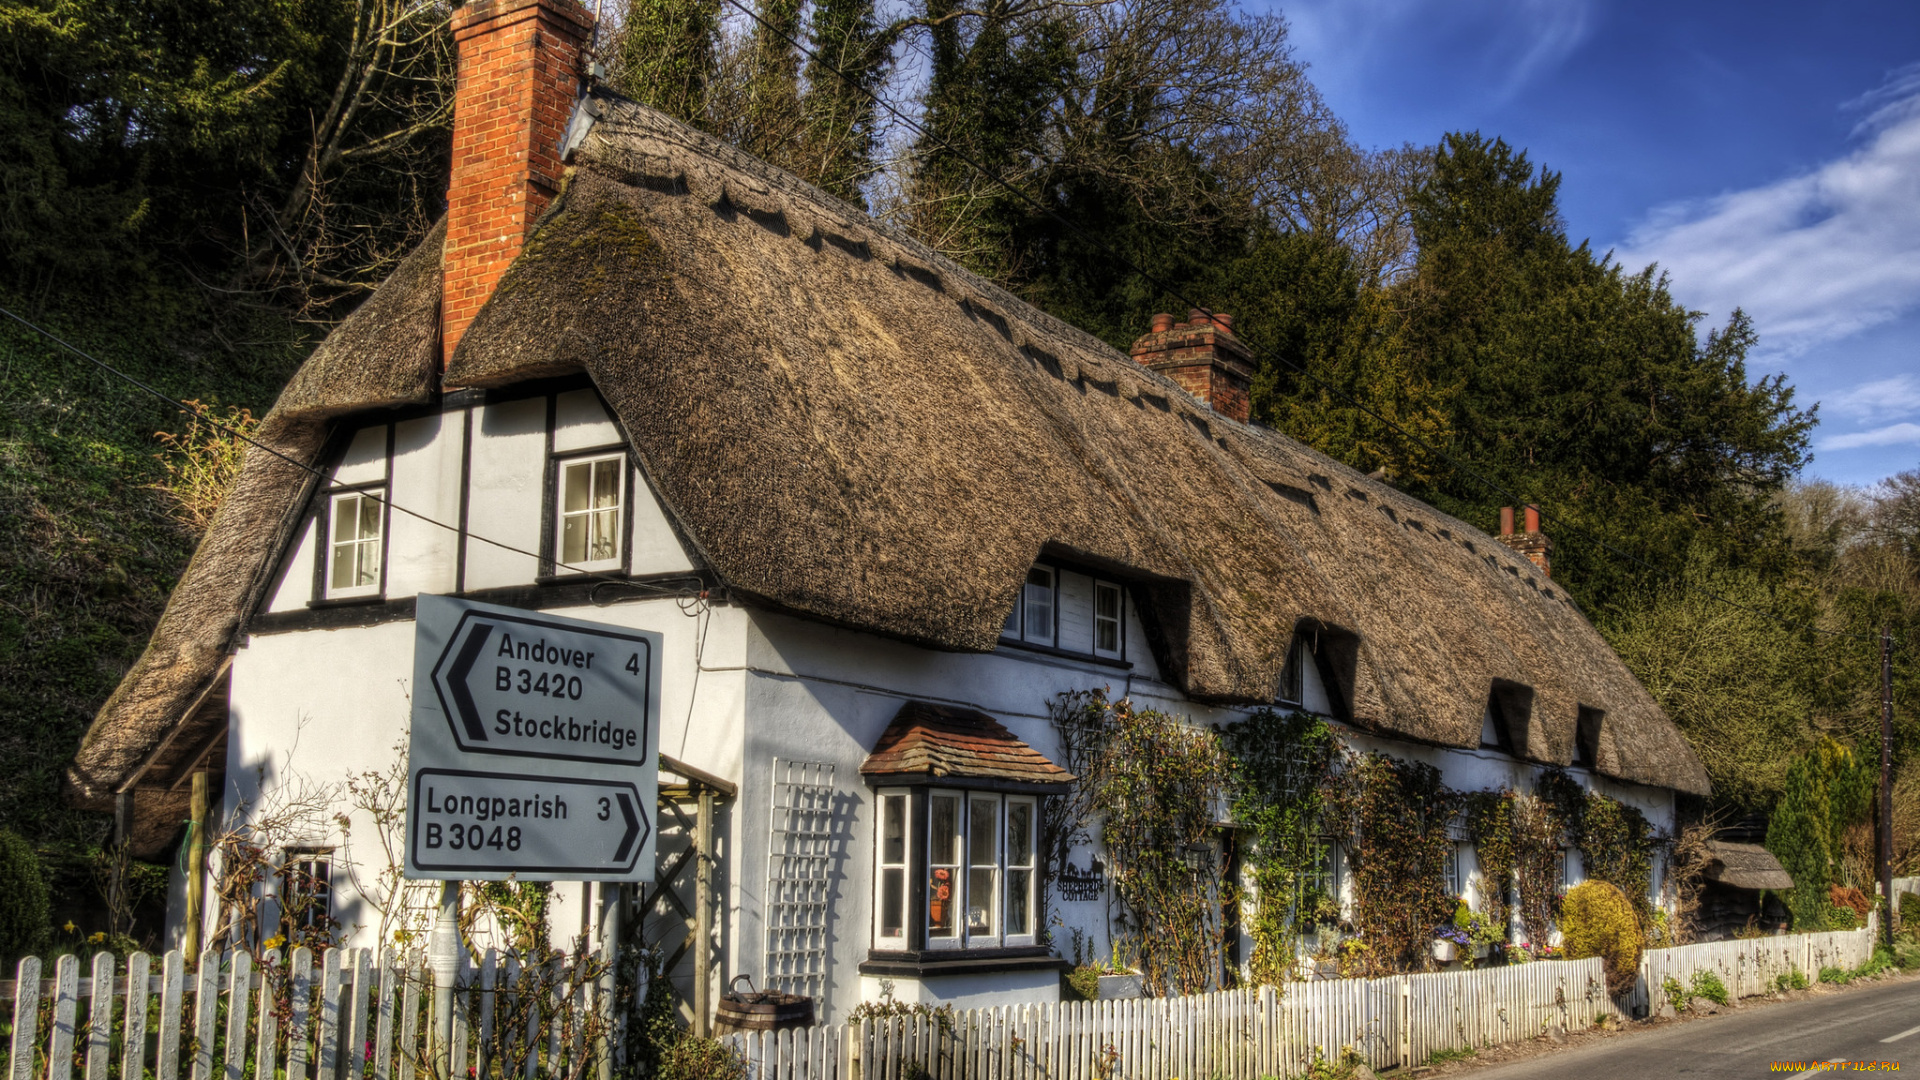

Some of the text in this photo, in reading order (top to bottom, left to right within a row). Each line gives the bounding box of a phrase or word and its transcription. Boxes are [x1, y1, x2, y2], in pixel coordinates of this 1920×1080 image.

[497, 632, 640, 676] Andover 4
[494, 708, 637, 750] Stockbridge
[427, 786, 611, 822] Longparish 3
[1062, 890, 1099, 901] COTTAGE
